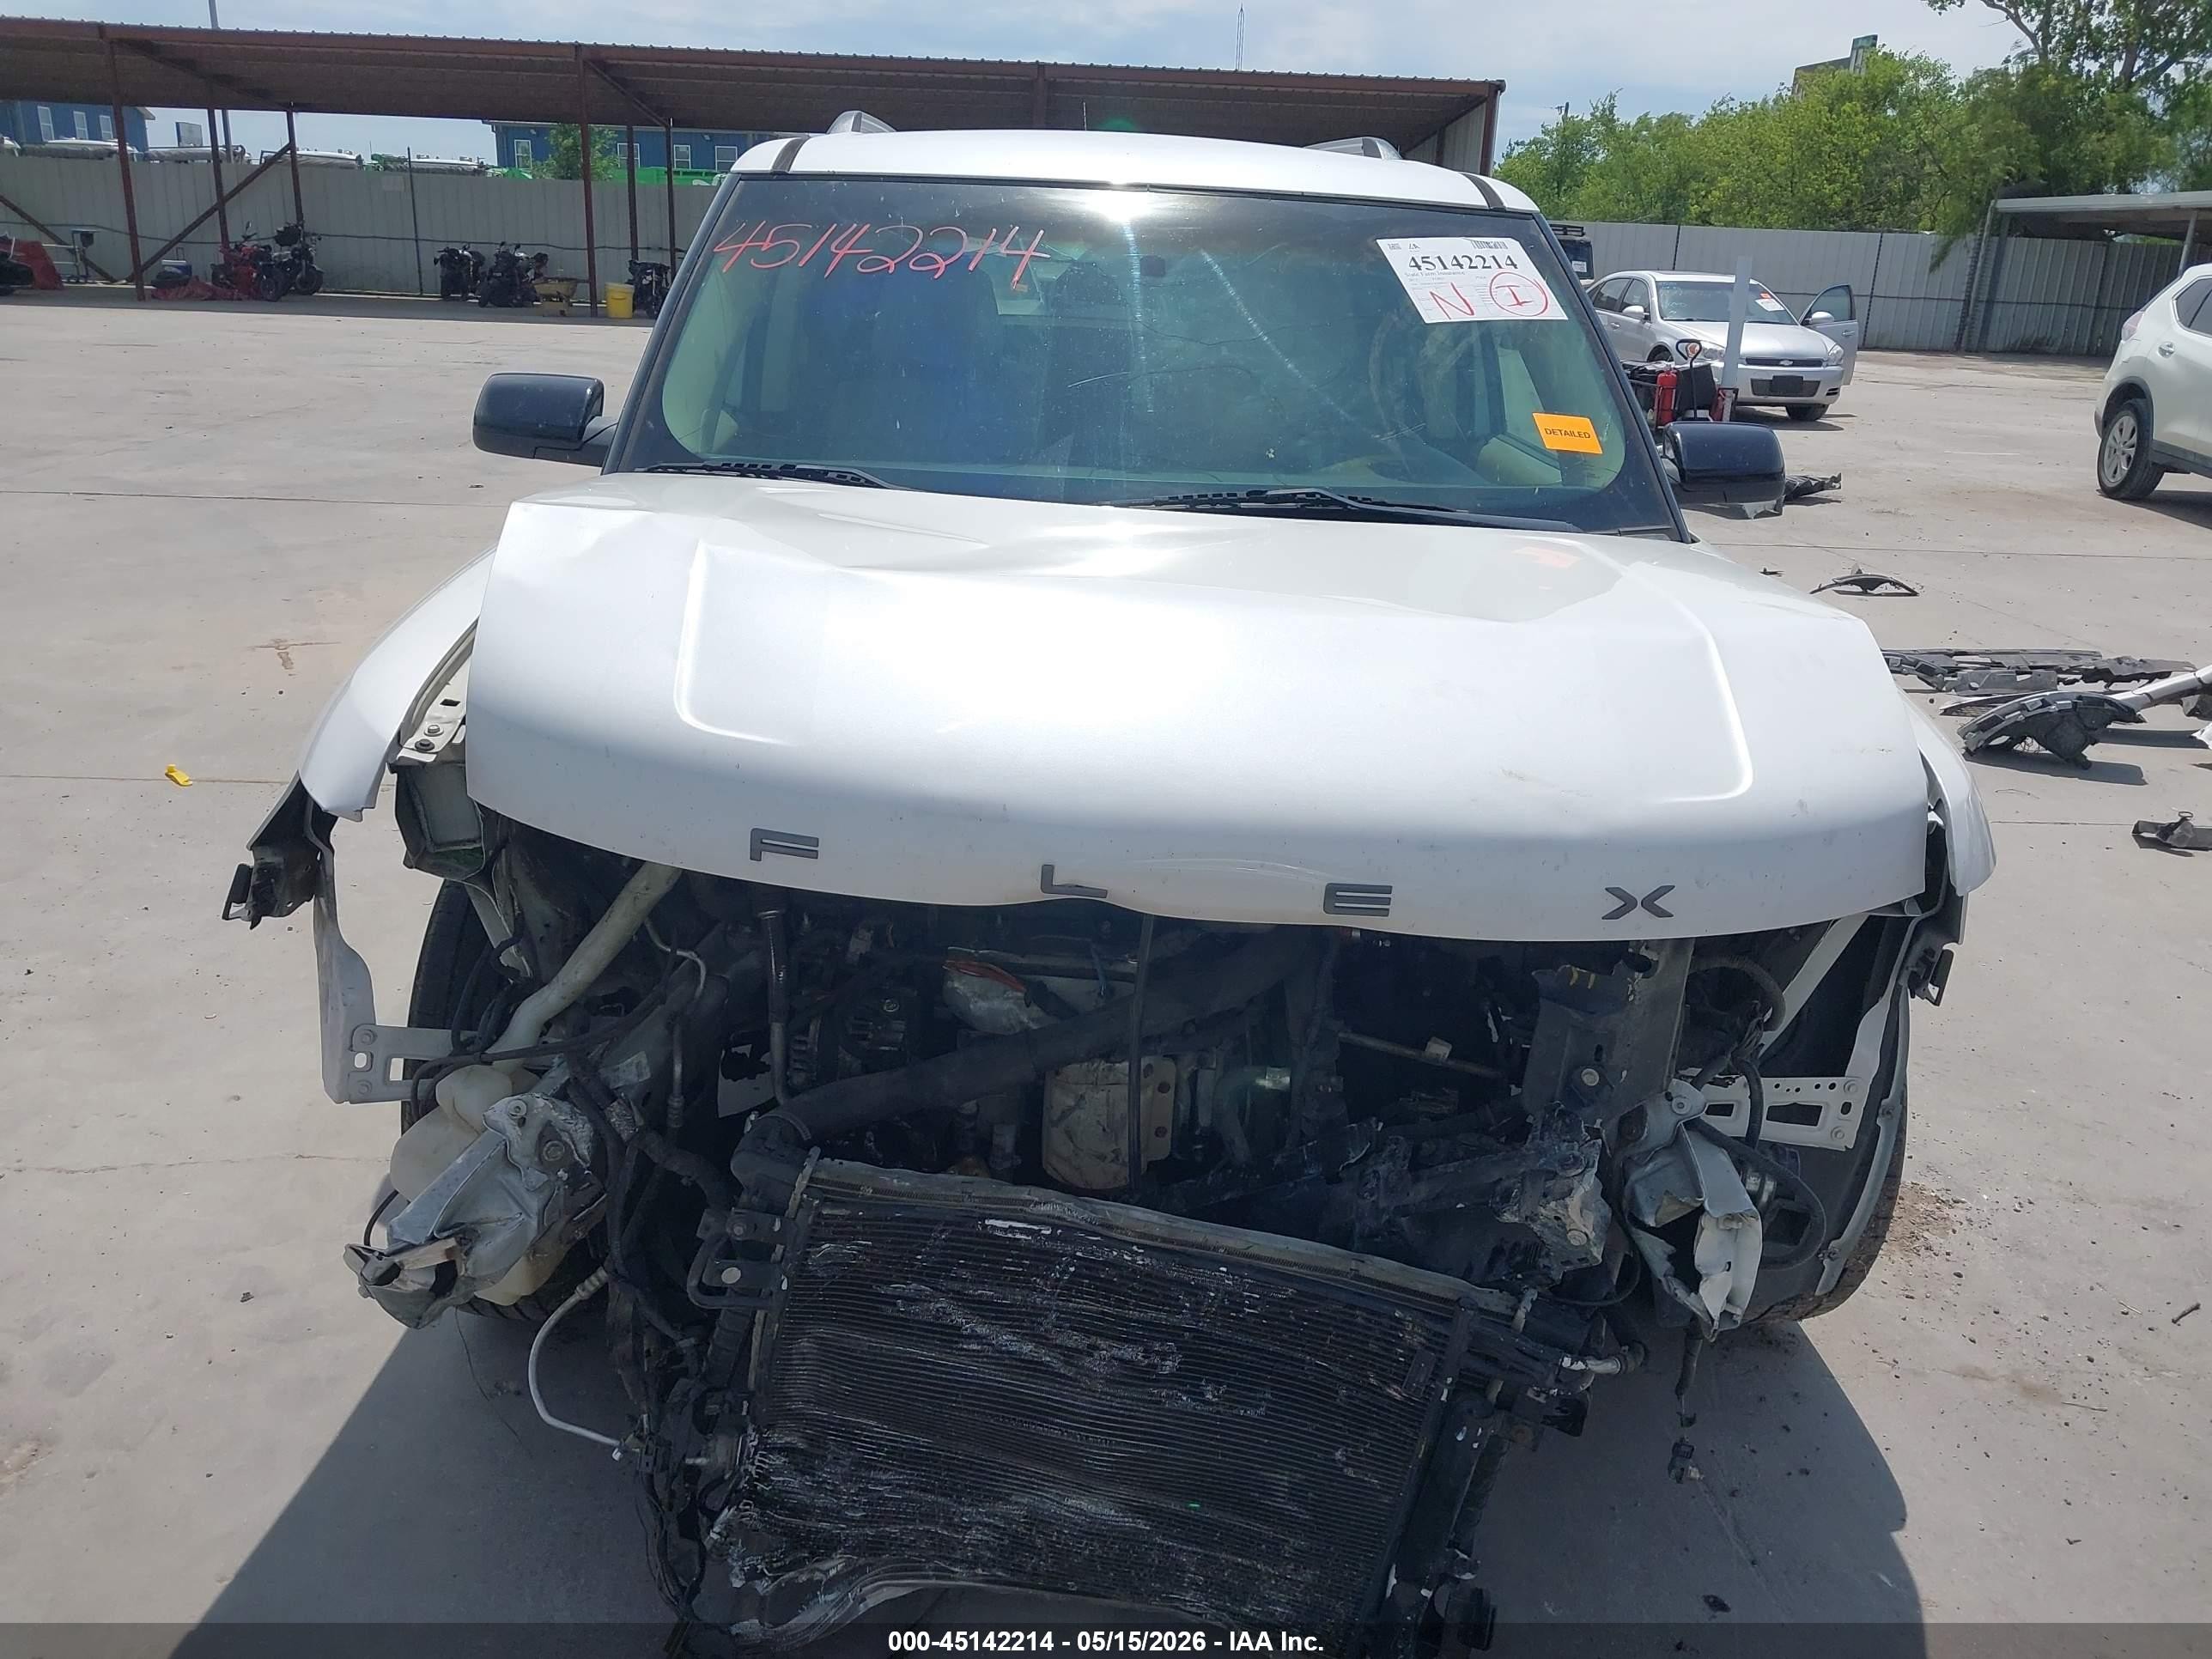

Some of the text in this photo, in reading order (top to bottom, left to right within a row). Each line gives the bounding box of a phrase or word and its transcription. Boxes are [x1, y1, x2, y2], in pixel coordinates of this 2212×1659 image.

[713, 220, 1050, 290] 45142214
[1408, 254, 1519, 270] 45142214
[1544, 427, 1591, 440] DETAILED
